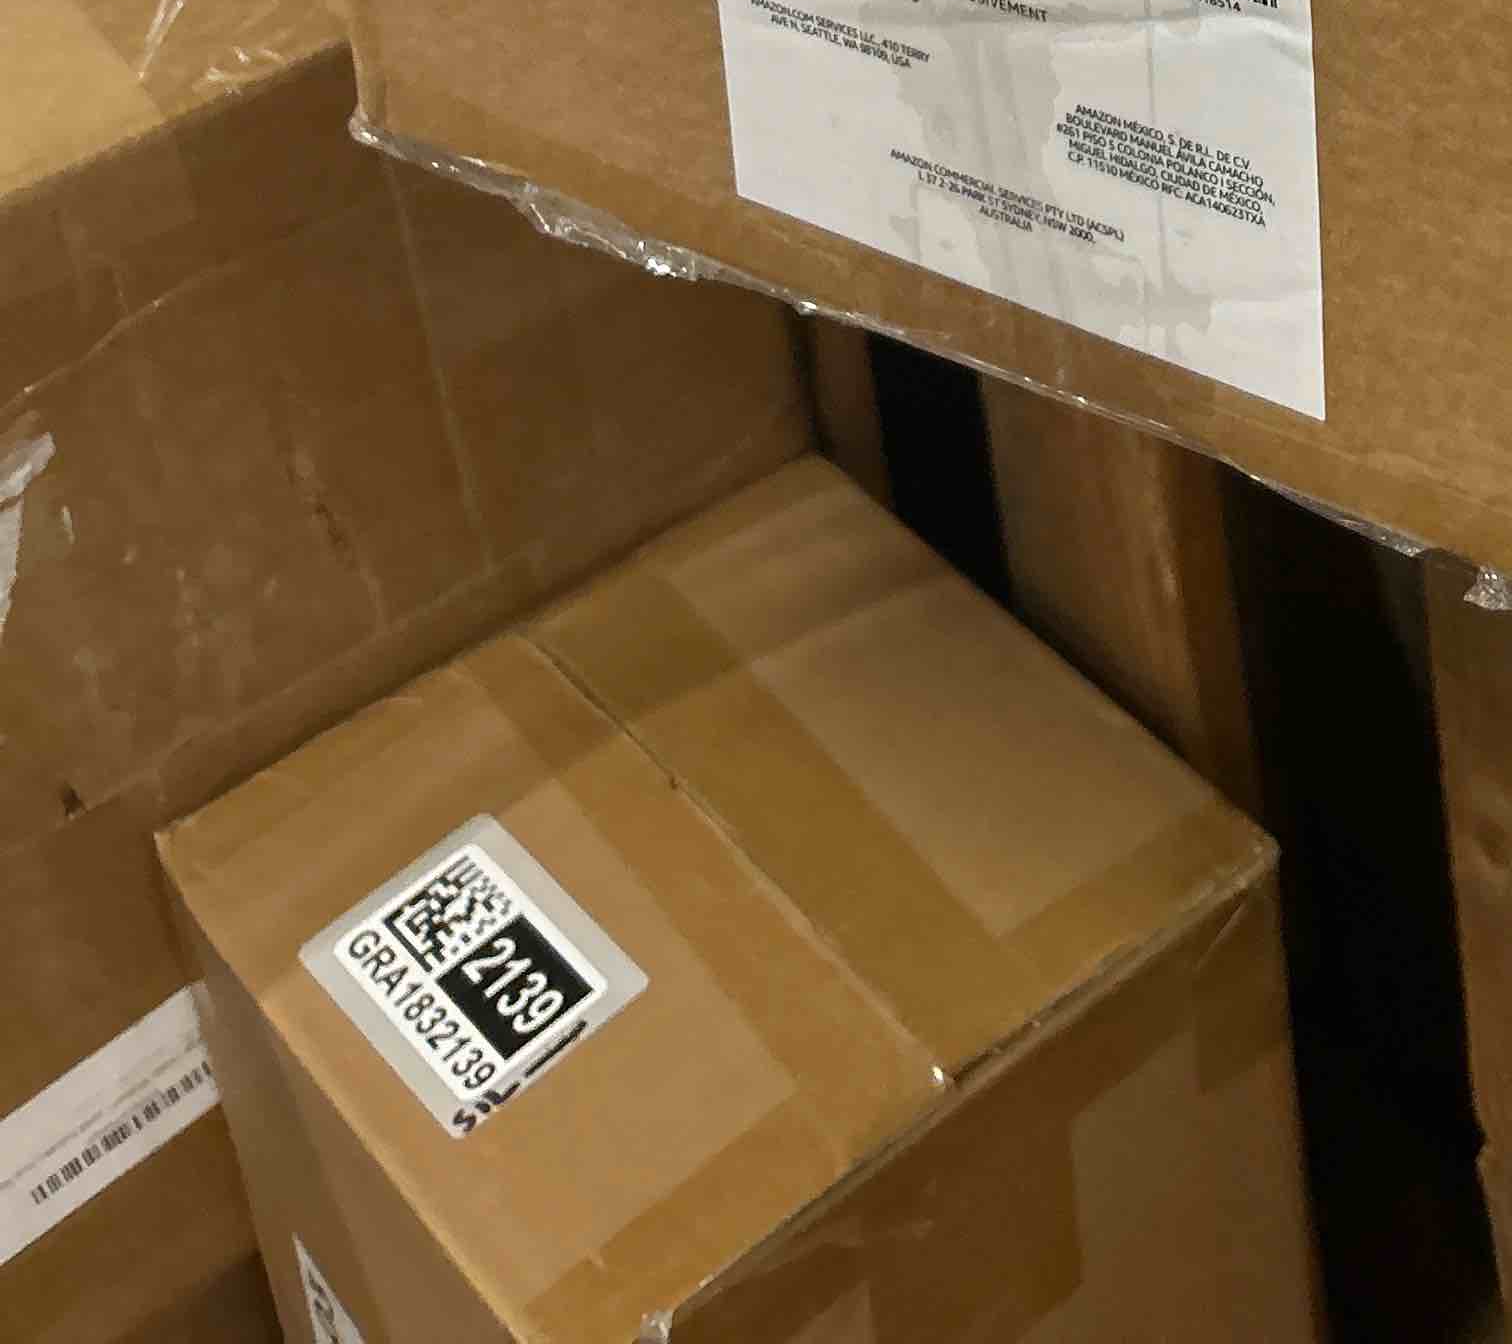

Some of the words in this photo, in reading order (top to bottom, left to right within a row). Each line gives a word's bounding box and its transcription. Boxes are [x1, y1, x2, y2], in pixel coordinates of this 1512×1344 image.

[1064, 211, 1086, 228] LTD
[348, 928, 497, 1091] GRA1832139
[461, 937, 565, 1035] 2139
